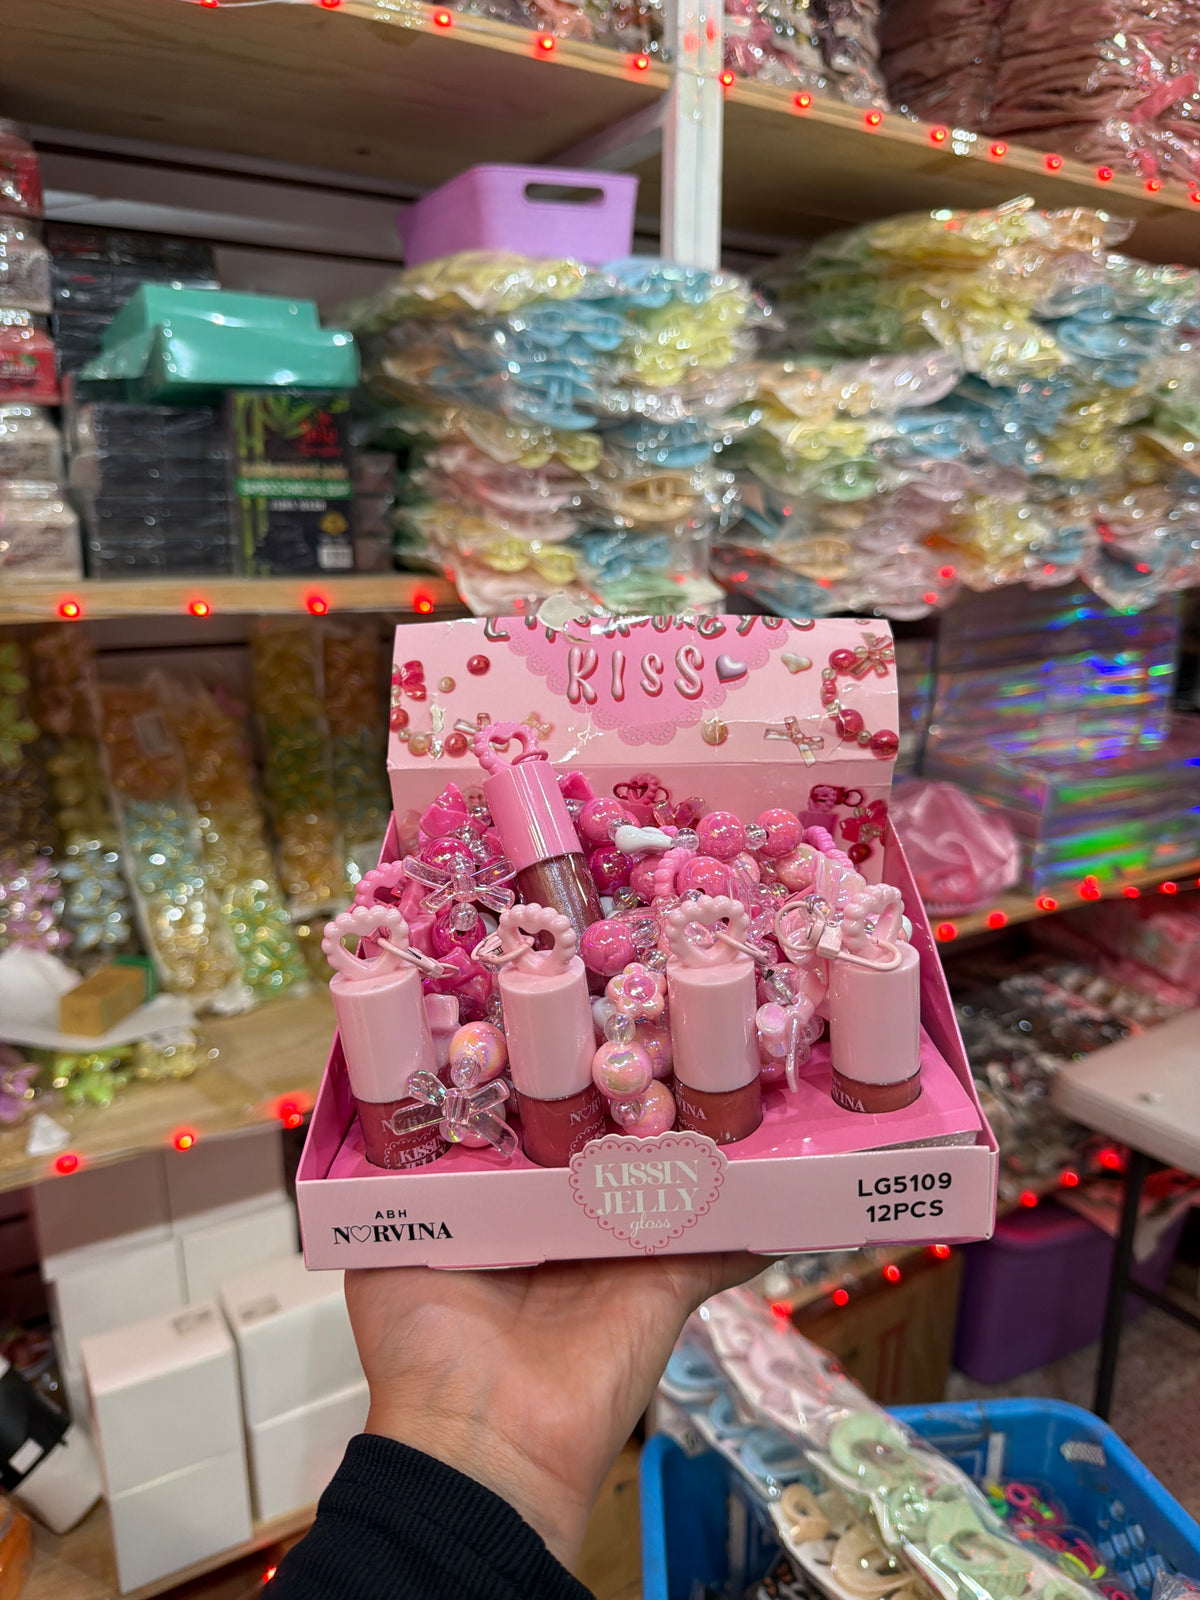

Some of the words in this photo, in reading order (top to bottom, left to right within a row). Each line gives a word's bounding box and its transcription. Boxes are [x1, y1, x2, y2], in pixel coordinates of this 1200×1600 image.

[567, 644, 704, 705] KISS
[594, 1159, 699, 1188] KISSIN
[857, 1172, 952, 1197] LG5109
[375, 1209, 407, 1219] ABH
[597, 1187, 699, 1215] JELLY
[866, 1200, 944, 1223] 12PCS
[630, 1211, 671, 1237] gloss
